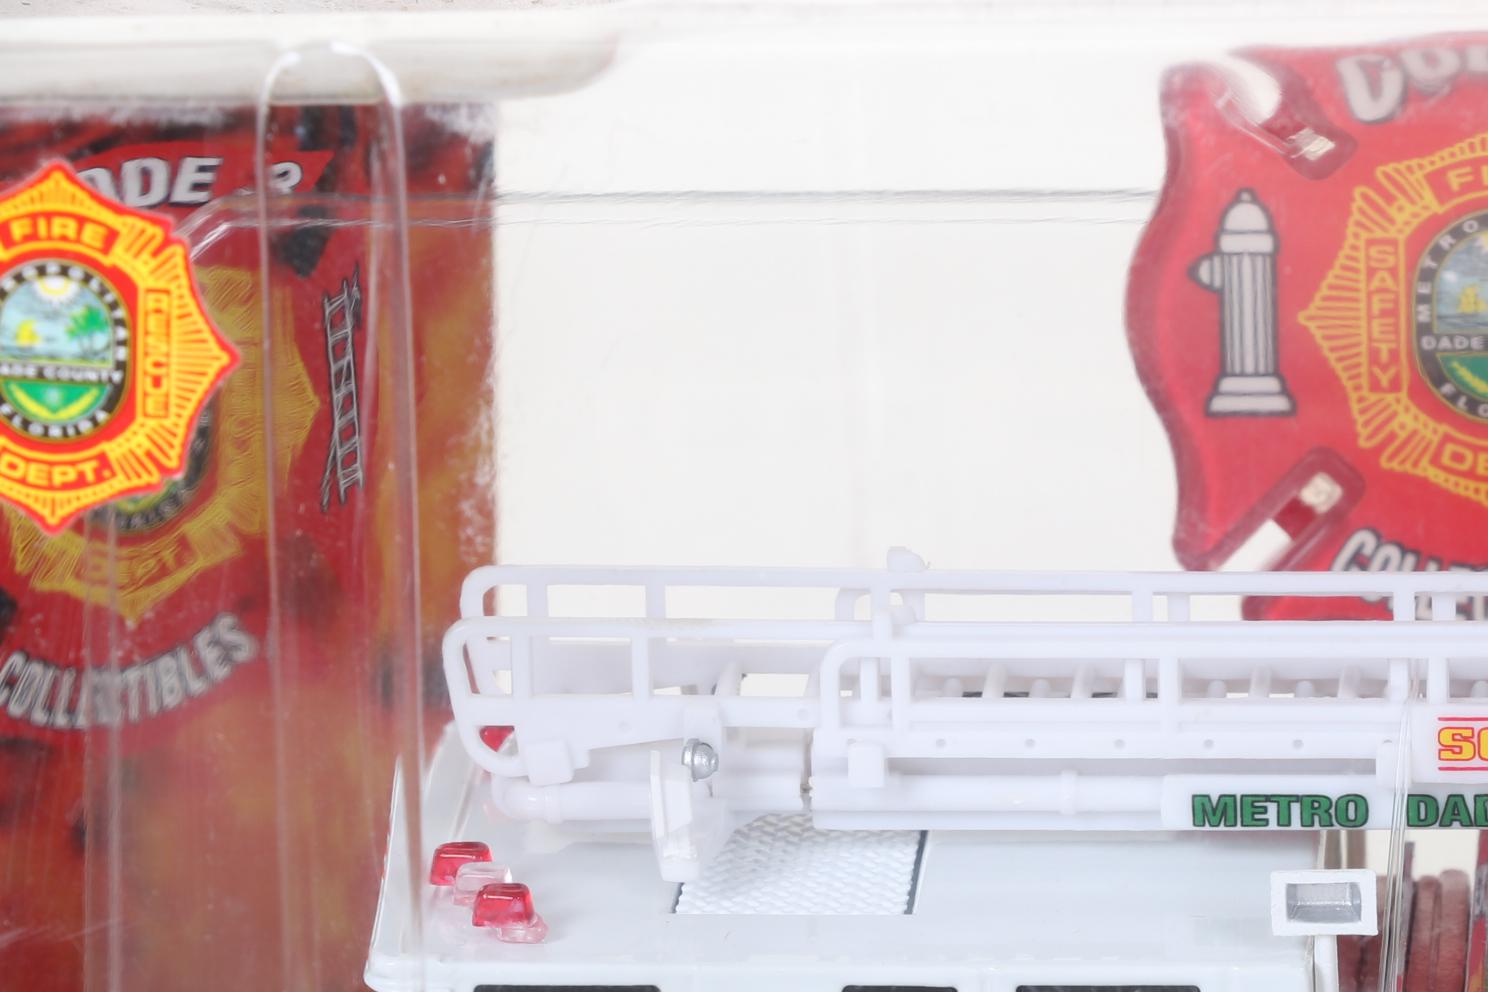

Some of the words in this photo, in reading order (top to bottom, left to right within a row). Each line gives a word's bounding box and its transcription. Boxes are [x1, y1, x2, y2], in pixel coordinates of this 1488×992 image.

[75, 156, 224, 208] ODE
[9, 215, 107, 249] FIRE
[1367, 244, 1399, 391] SAFETY
[144, 290, 170, 417] RESCUE
[1420, 336, 1484, 350] DADE
[43, 362, 123, 384] COUNTY
[1191, 793, 1369, 828] METRO
